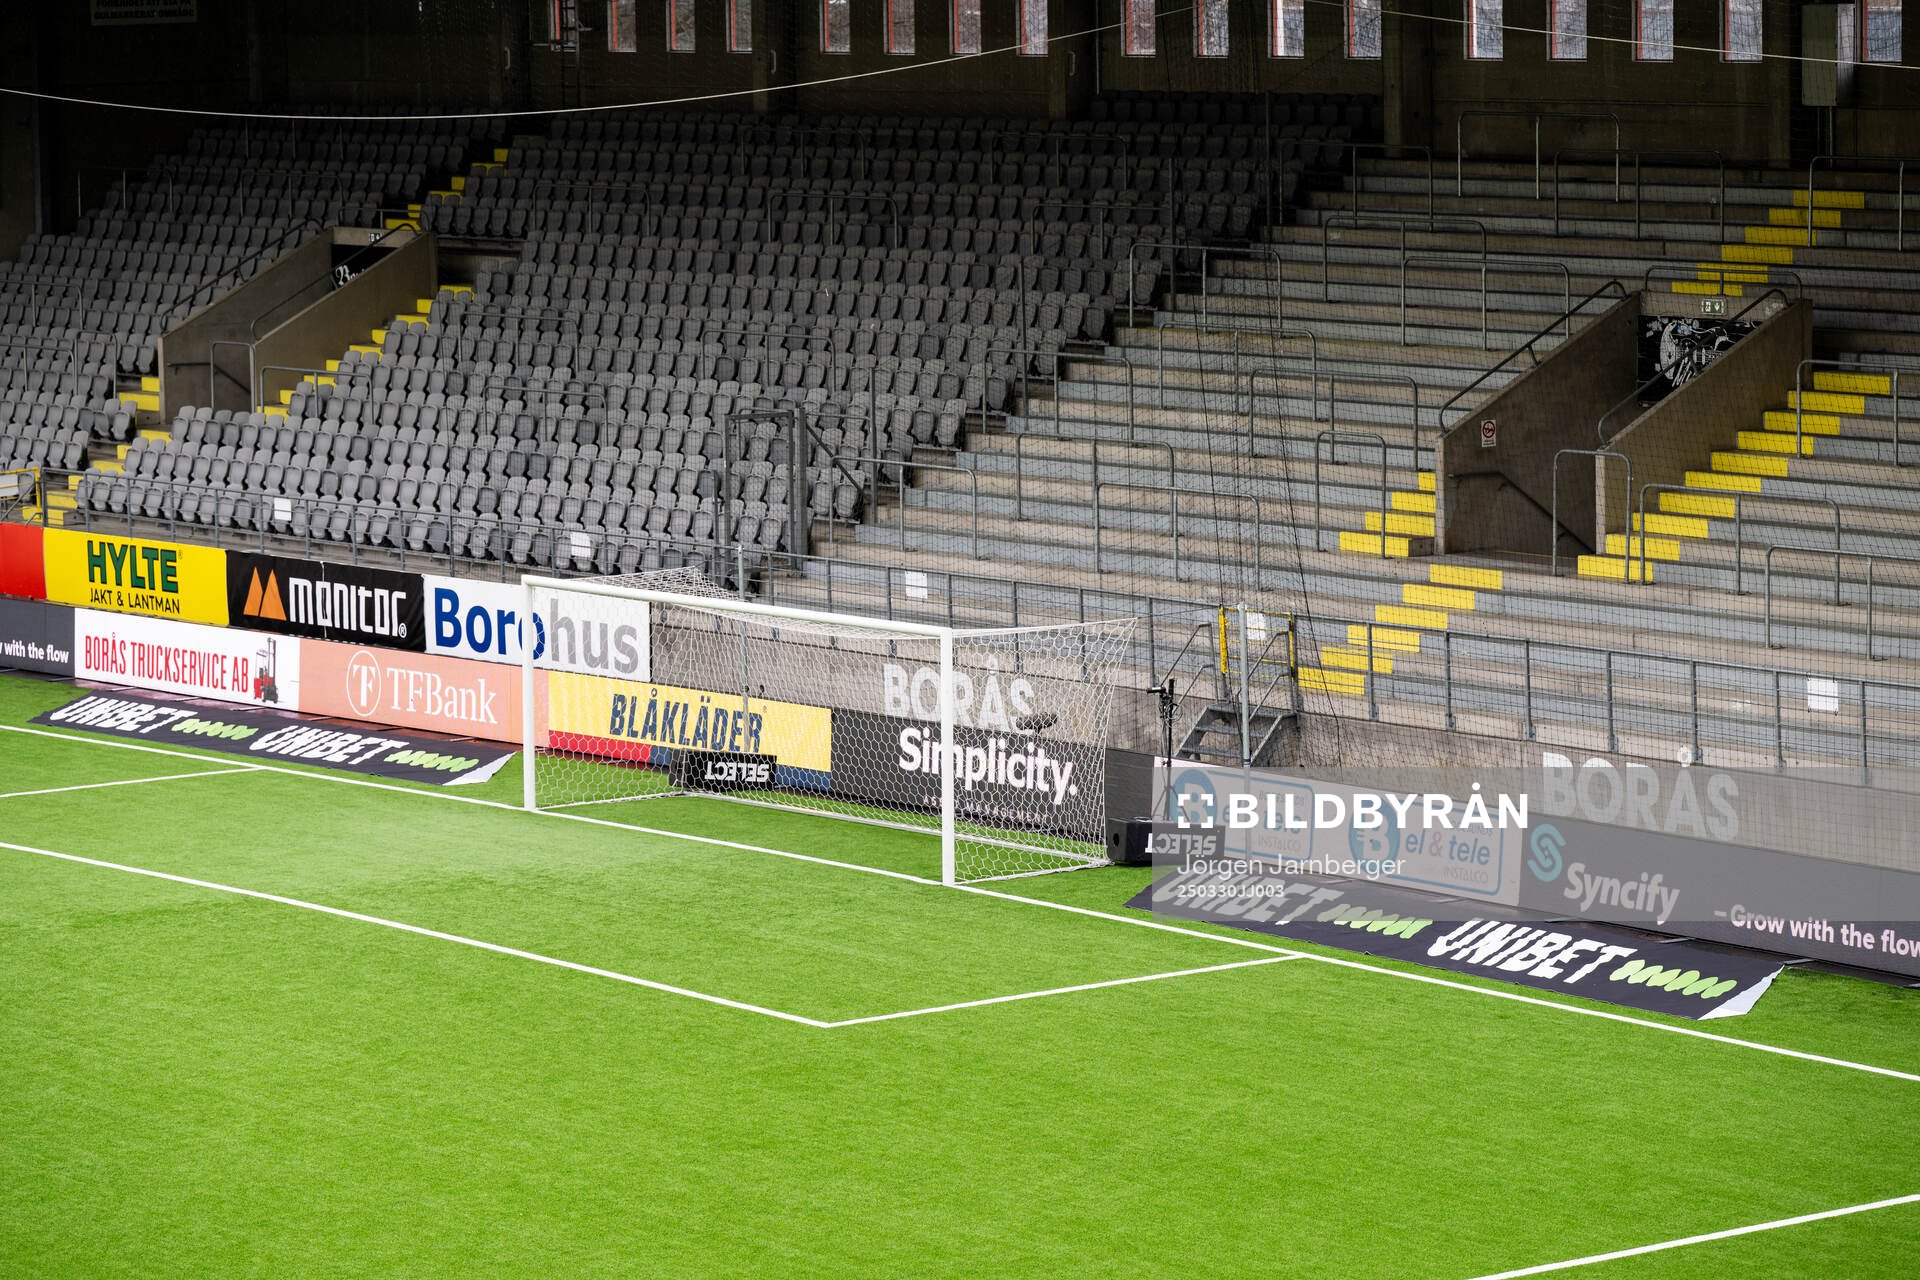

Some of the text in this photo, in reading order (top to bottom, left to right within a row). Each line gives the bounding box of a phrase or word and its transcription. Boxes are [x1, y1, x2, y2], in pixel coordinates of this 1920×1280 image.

[90, 588, 180, 614] JAKT & LANTMAN
[4, 640, 26, 657] with
[28, 642, 44, 659] the
[46, 644, 69, 663] flow
[85, 632, 249, 693] BORÅS TRUCKSERVICE AB
[50, 696, 198, 734] UNIBET
[387, 667, 497, 724] TFBank
[610, 687, 763, 752] BLÅKLÄDER
[883, 655, 1035, 735] BORÅS
[250, 725, 408, 765] UNIBET
[704, 760, 770, 782] SELECT
[1543, 745, 1739, 841] BORÅS
[1145, 833, 1216, 855] SELECT
[1405, 829, 1490, 865] el & tele
[1152, 867, 1345, 925] UNIBET
[1563, 862, 1680, 926] Syncify
[1427, 918, 1639, 983] UNIBET
[1730, 904, 1785, 934] Grow
[1790, 917, 1834, 943] with
[1840, 923, 1875, 950] the
